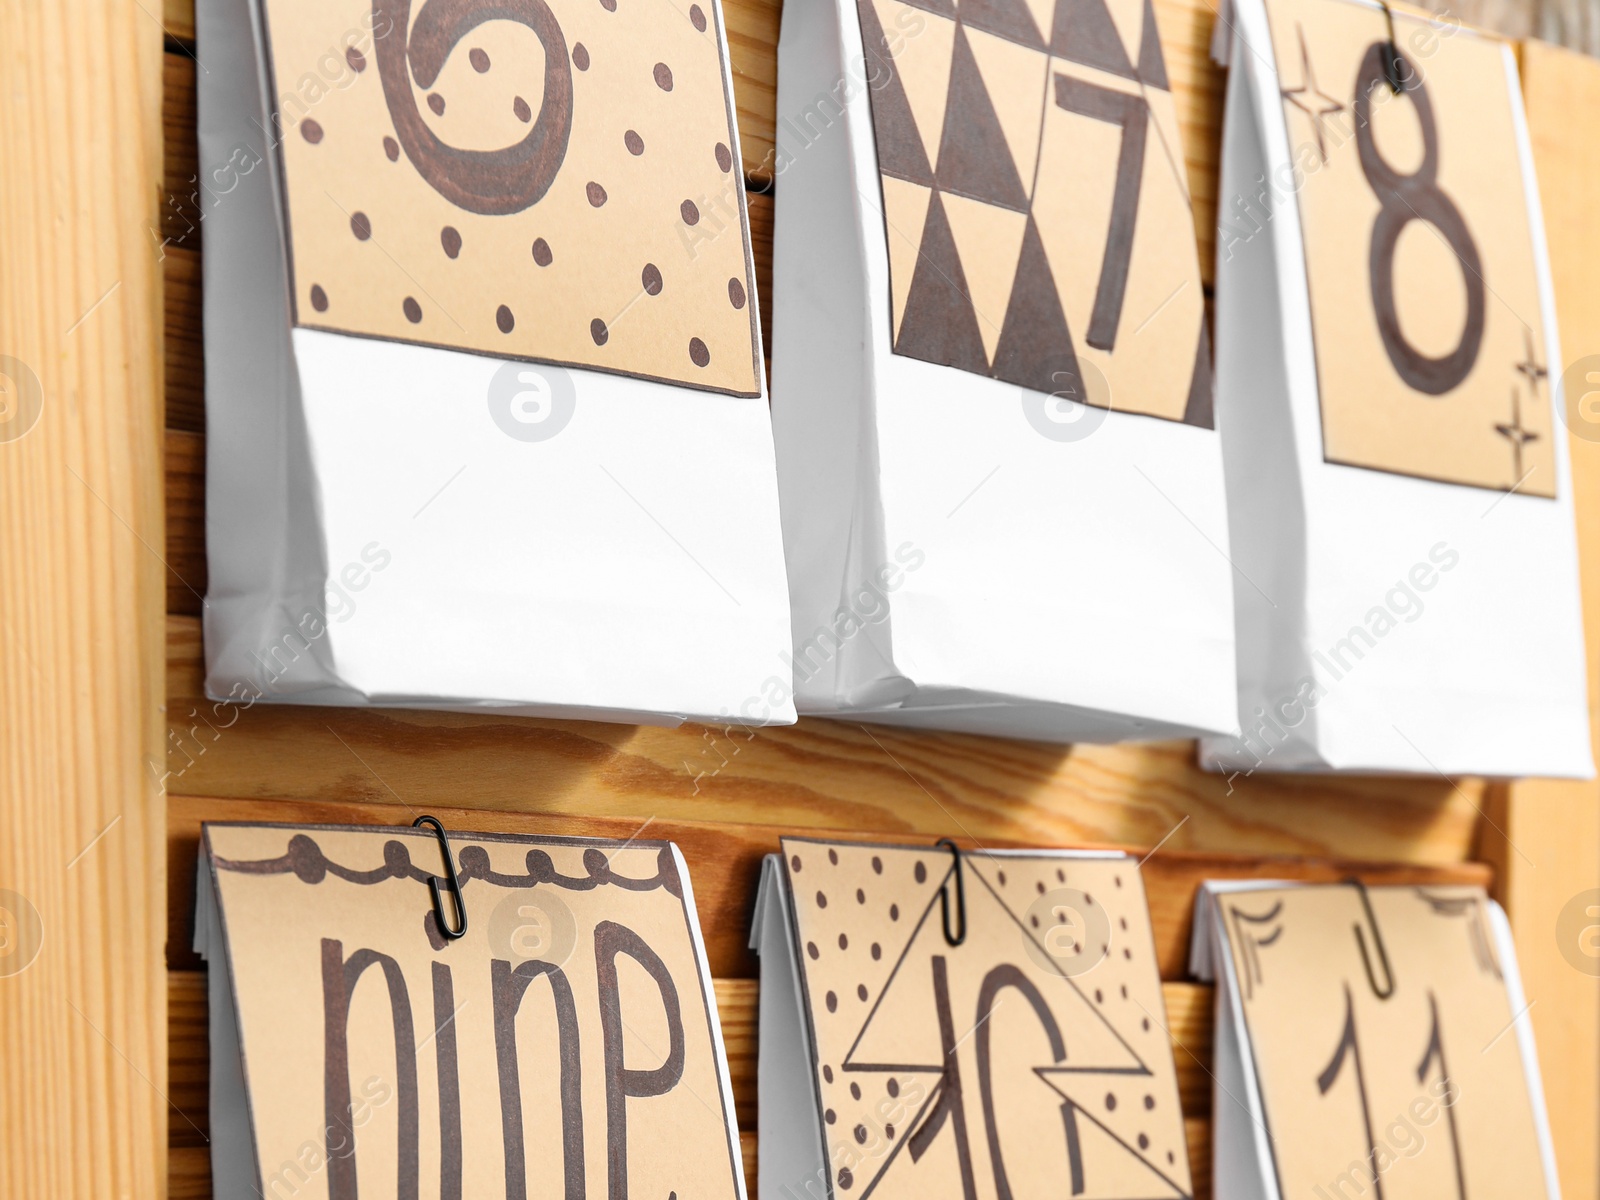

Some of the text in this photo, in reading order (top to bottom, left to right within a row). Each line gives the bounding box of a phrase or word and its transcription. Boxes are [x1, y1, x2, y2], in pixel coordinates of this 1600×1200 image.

[372, 0, 574, 216] 6
[1053, 72, 1149, 354] 7
[1353, 40, 1486, 396] 8
